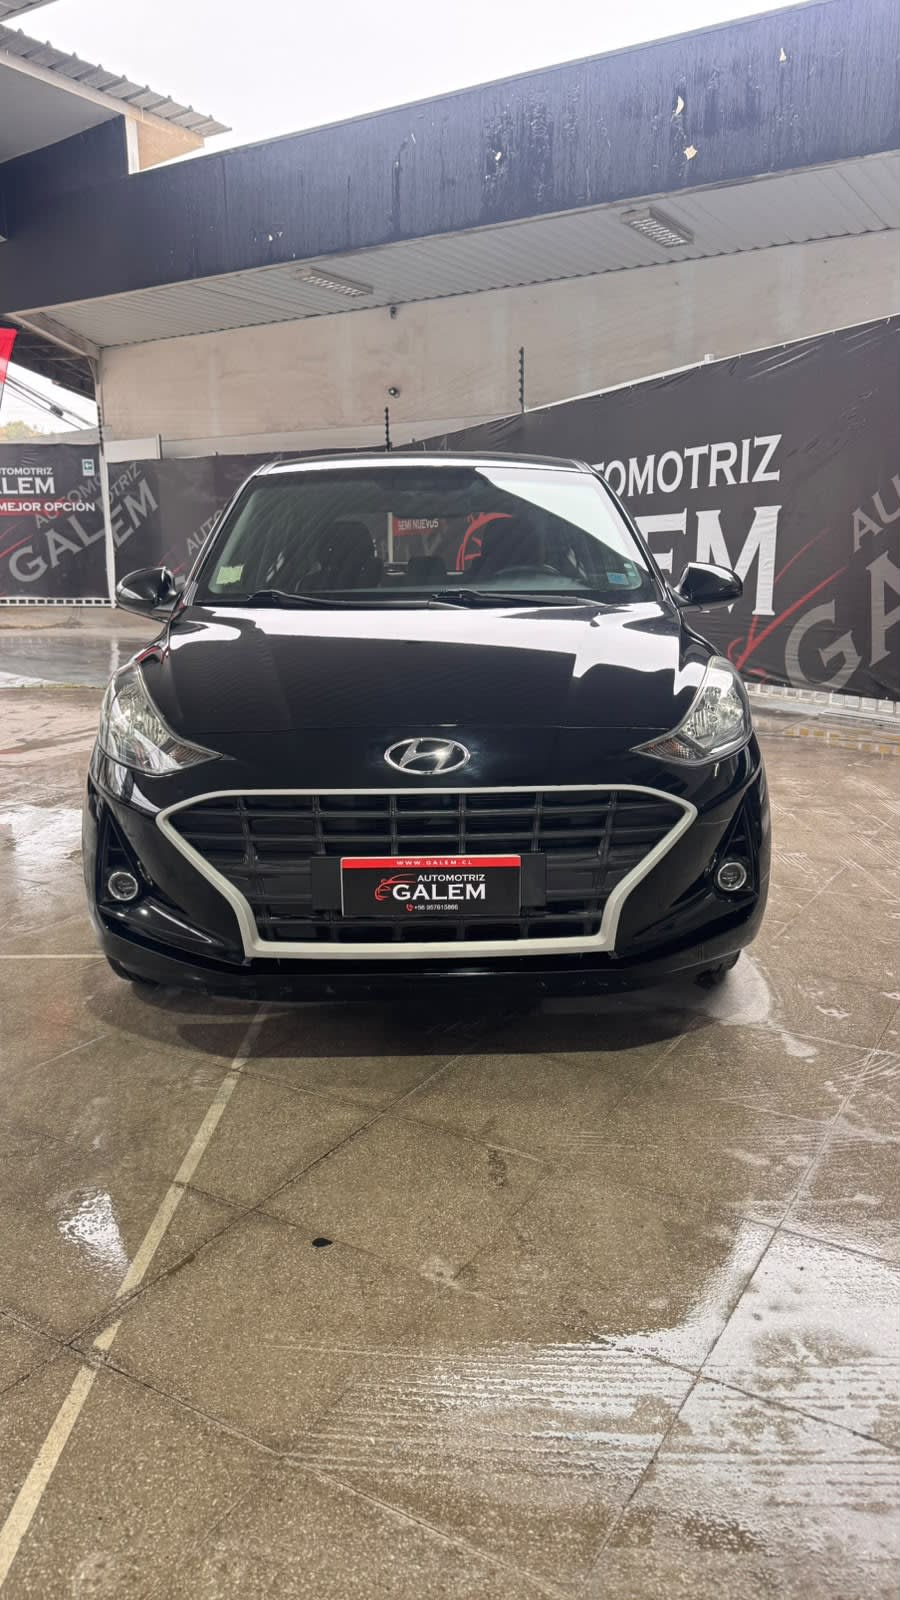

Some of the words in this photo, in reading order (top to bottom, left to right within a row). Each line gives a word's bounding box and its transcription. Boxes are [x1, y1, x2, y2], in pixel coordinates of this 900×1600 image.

[0, 467, 53, 476] TOMOTRIZ
[592, 434, 782, 498] OMOTRIZ
[0, 477, 56, 494] LEM
[0, 502, 41, 512] MEJOR
[44, 499, 96, 512] OPCIÓN
[417, 874, 486, 882] AUTOMOTRIZ
[392, 883, 486, 901] GALEM
